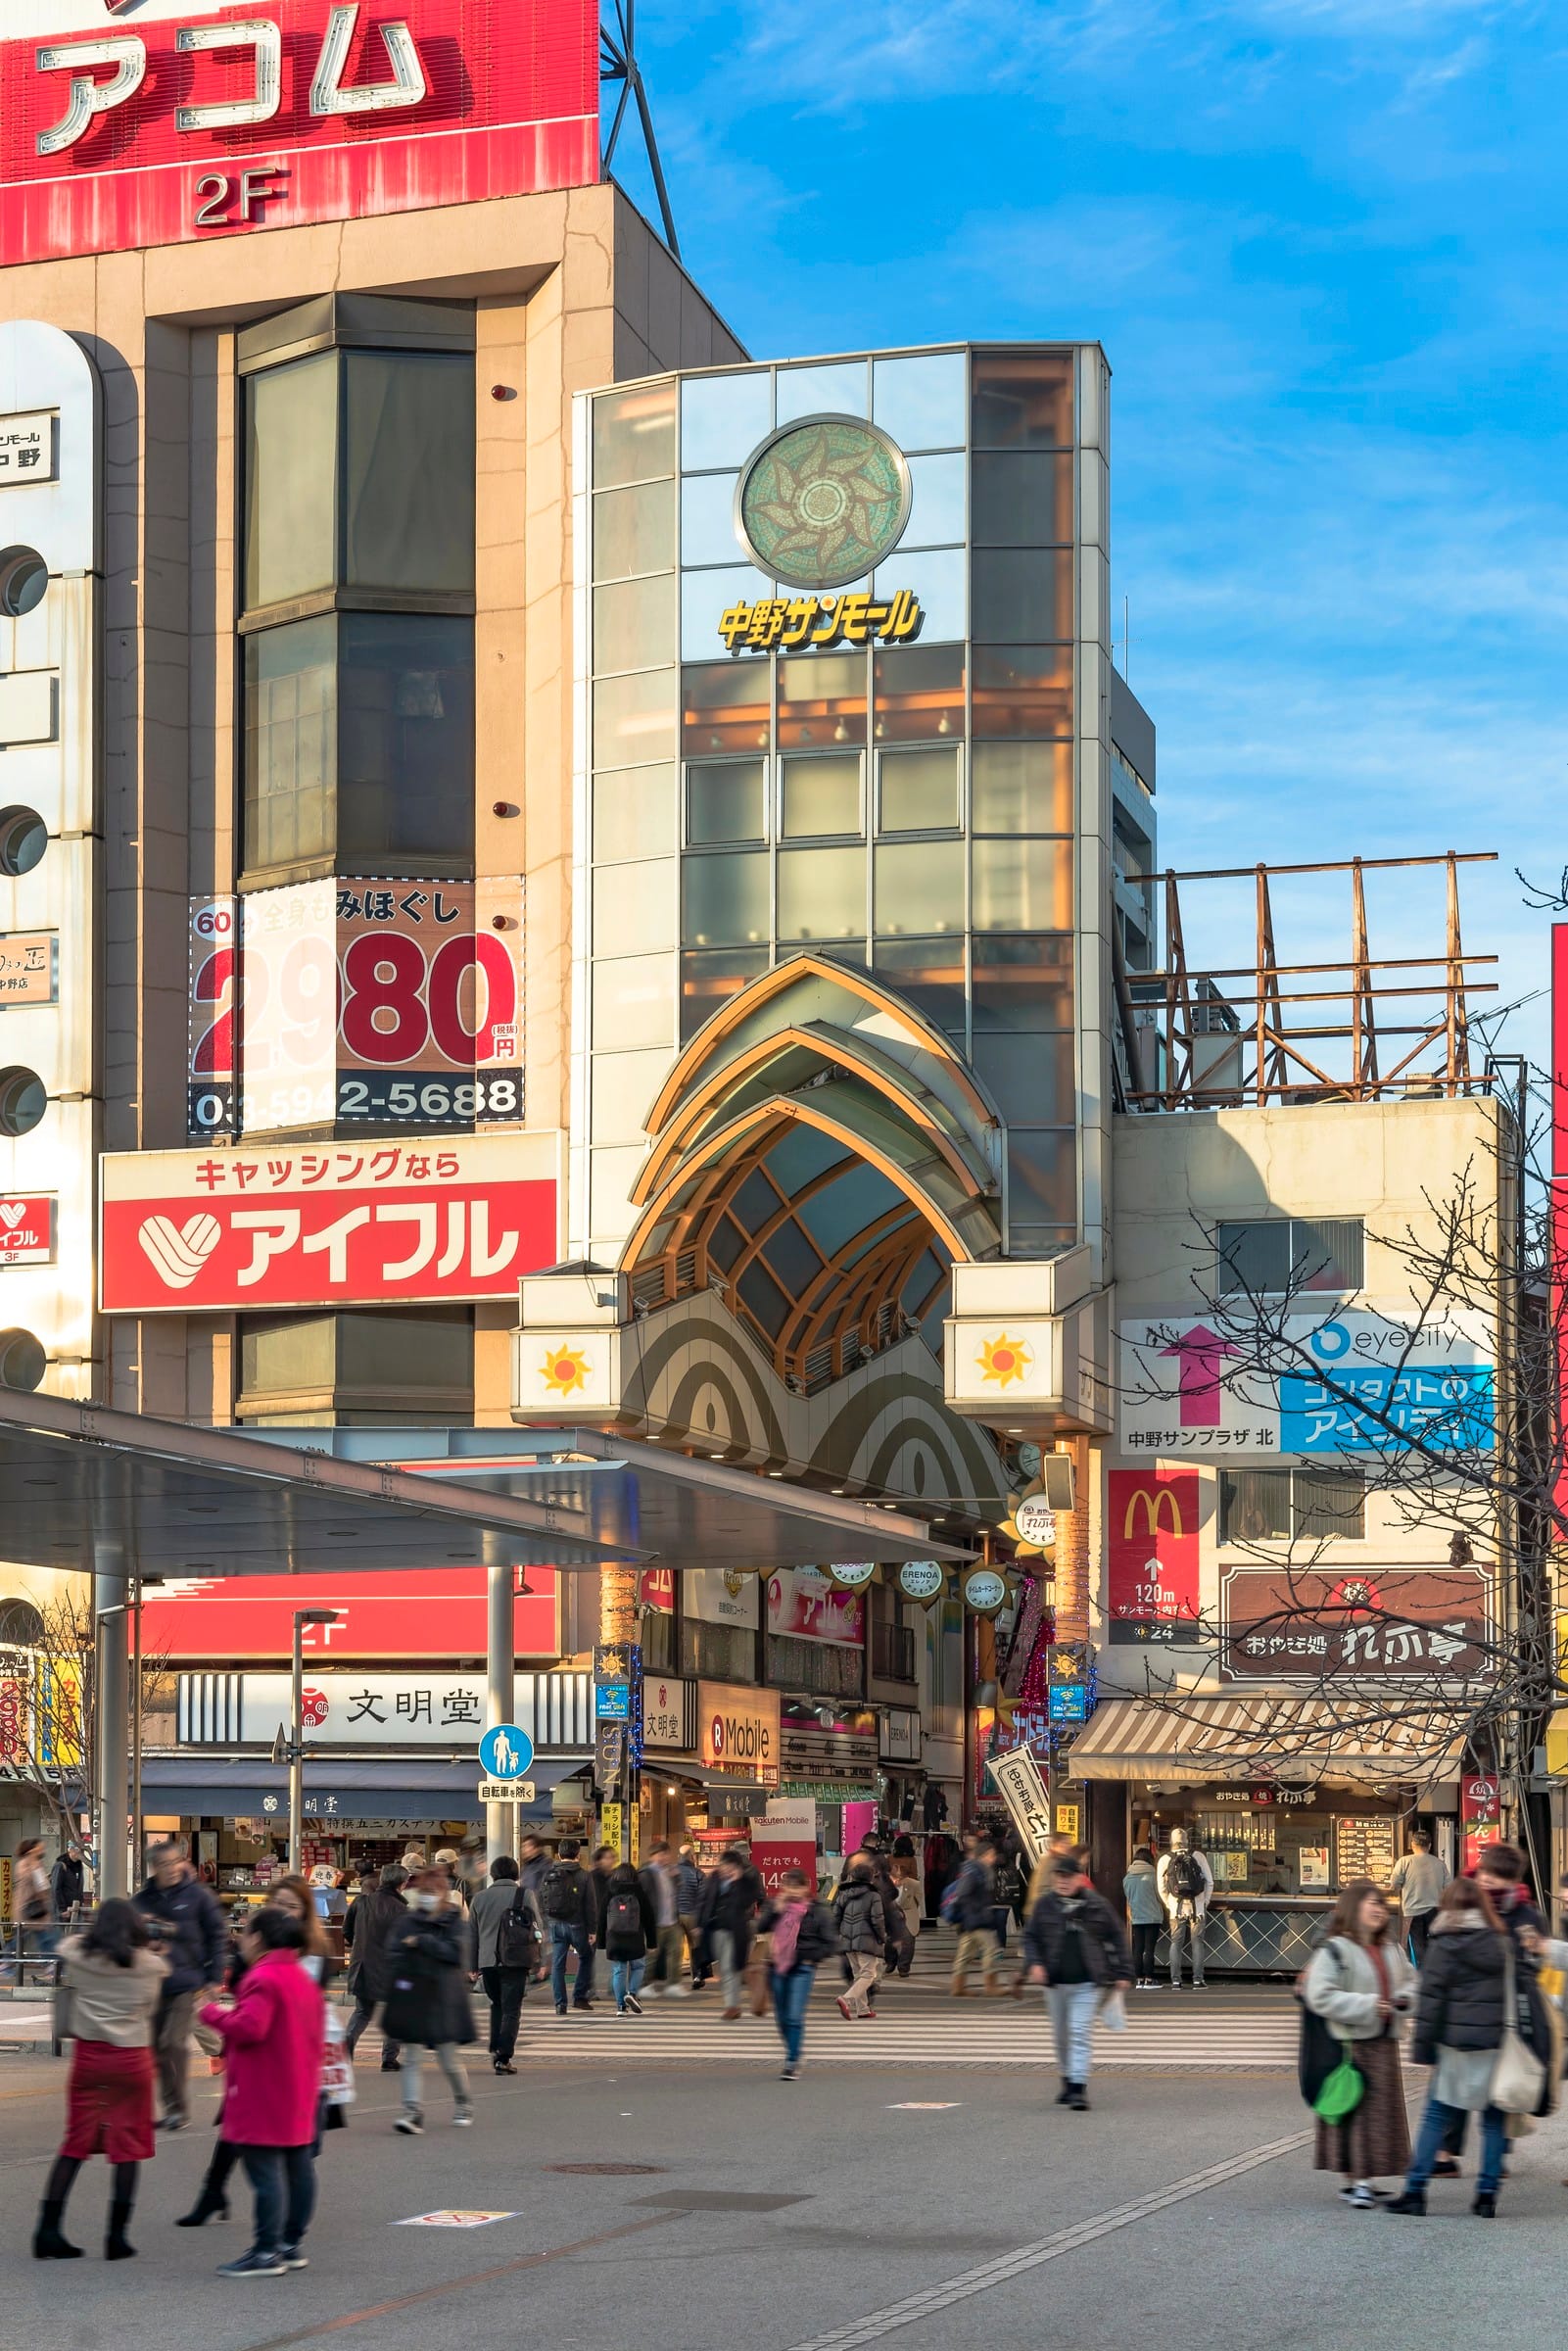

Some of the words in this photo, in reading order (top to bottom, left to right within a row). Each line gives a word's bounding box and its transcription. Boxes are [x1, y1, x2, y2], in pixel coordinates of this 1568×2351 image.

[36, 3, 427, 157] アコム
[194, 167, 277, 226] 2F
[719, 590, 921, 650] 中野サンモール
[192, 931, 517, 1076] 2980
[497, 1038, 515, 1058] 円
[196, 1149, 460, 1190] キャッシングなら
[230, 1200, 519, 1287] アイフル
[5, 1252, 20, 1262] 3F
[1354, 1325, 1458, 1355] eyecity
[902, 1570, 939, 1579] ERENOA
[1135, 1584, 1175, 1603] 120m
[1151, 1624, 1174, 1640] 24
[1246, 1635, 1327, 1655] おやき処
[1340, 1622, 1467, 1665] れふ亭
[347, 1689, 481, 1725] 文明堂
[647, 1713, 678, 1739] 文明堂
[726, 1717, 769, 1758] Mobile
[602, 1726, 621, 1785] SUN
[287, 1796, 338, 1812] 明堂
[482, 1786, 532, 1799] 自転車を除く
[1215, 1792, 1251, 1801] おやき処
[754, 1817, 784, 1826] Rakuten
[785, 1816, 809, 1825] Mobile
[762, 1857, 801, 1866] だれでも
[315, 1870, 333, 1881] 迎春
